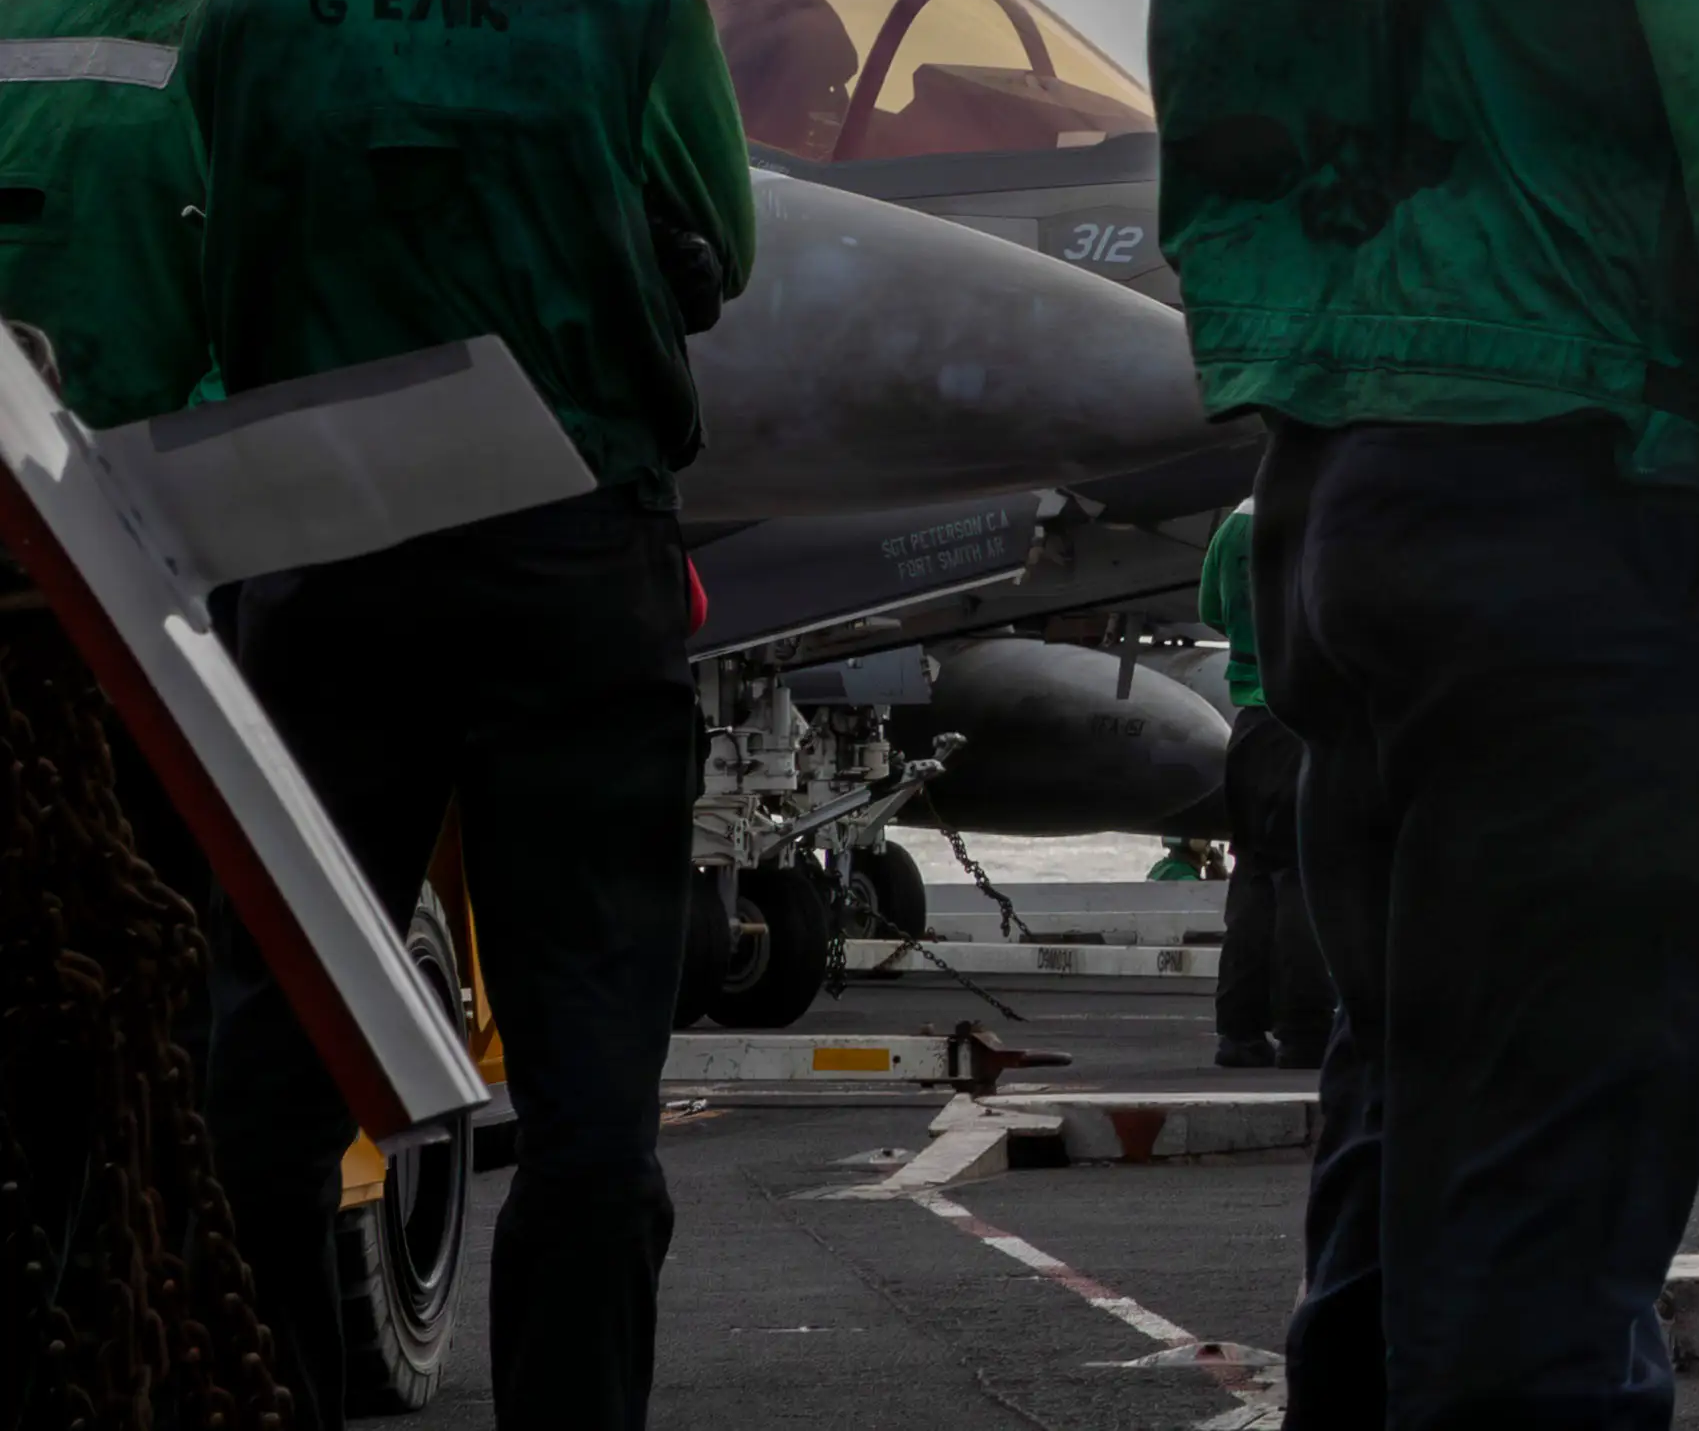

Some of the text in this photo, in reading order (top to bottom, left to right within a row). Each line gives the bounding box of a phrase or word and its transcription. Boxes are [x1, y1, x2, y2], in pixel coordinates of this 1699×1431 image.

[1063, 222, 1145, 263] 312
[881, 536, 909, 559] SGT
[910, 515, 983, 546] PETERSON
[897, 536, 1006, 579] FORT SMITH AR
